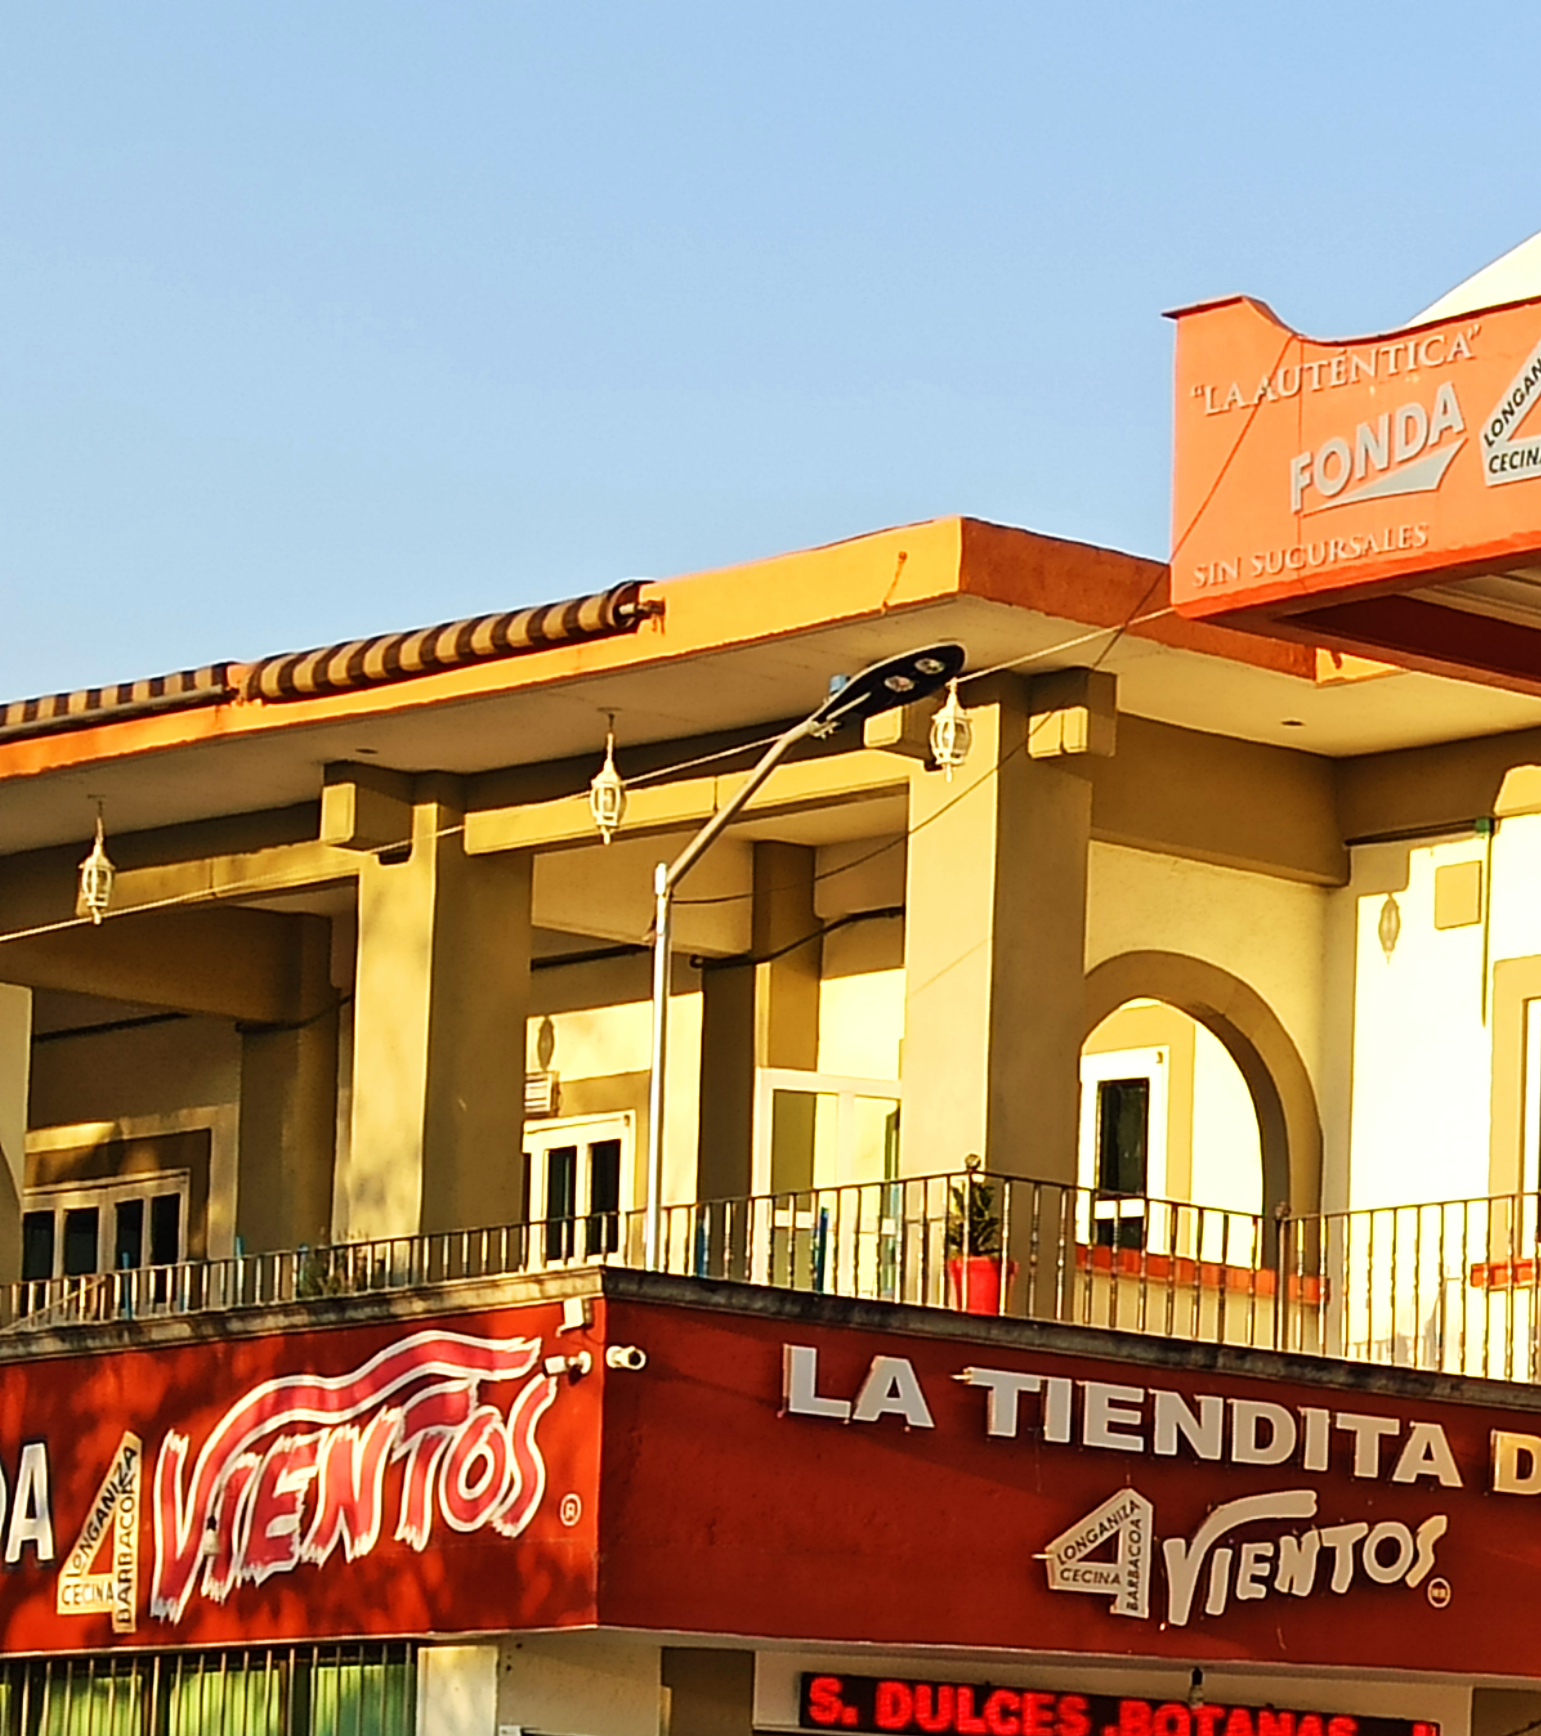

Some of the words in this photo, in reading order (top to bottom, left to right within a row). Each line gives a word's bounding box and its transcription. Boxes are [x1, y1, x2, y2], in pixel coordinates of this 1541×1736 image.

[1289, 380, 1467, 515] FONDA
[1192, 556, 1244, 588] SIN
[1250, 523, 1430, 577] SUCURSALES
[782, 1343, 935, 1429] LA
[955, 1365, 1464, 1489] TIENDITA
[0, 1442, 55, 1564] A
[57, 1430, 143, 1634] 4
[150, 1329, 558, 1625] VIENTOS
[66, 1445, 139, 1578] LONGANIZA
[1056, 1499, 1140, 1565] LONGANIZA
[61, 1581, 115, 1606] CECINA
[115, 1472, 136, 1625] BARBACOA
[1043, 1486, 1154, 1619] 4
[1161, 1489, 1449, 1627] VIENTOS
[1058, 1568, 1122, 1587] CECINA
[1126, 1518, 1142, 1612] BARBACOA
[808, 1676, 859, 1726] S.
